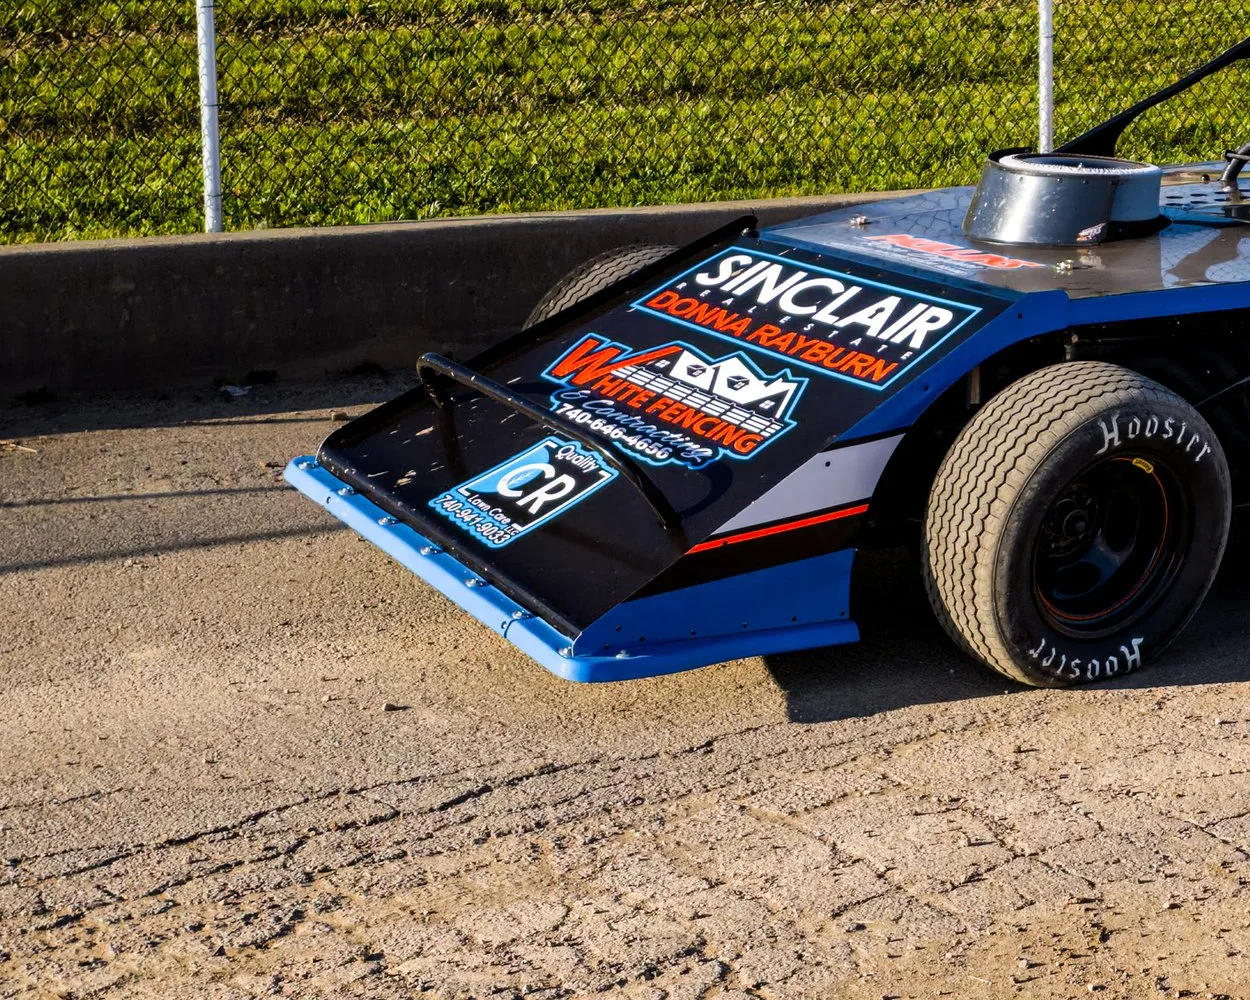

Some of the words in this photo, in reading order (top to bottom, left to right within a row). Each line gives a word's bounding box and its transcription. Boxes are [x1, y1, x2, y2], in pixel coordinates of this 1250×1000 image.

[695, 254, 953, 350] SINCLAIR
[646, 289, 753, 337] DONNA
[749, 323, 899, 383] RAYBURN
[552, 338, 684, 409] WHITE
[646, 396, 766, 454] FENCING
[554, 444, 601, 473] Quality
[556, 402, 673, 460] 740-646-4656
[581, 399, 713, 463] Contracting
[467, 494, 492, 513] Lawn
[489, 507, 512, 526] Care
[504, 524, 520, 536] LLC
[496, 462, 576, 515] CR
[435, 494, 511, 545] 740-941-9033
